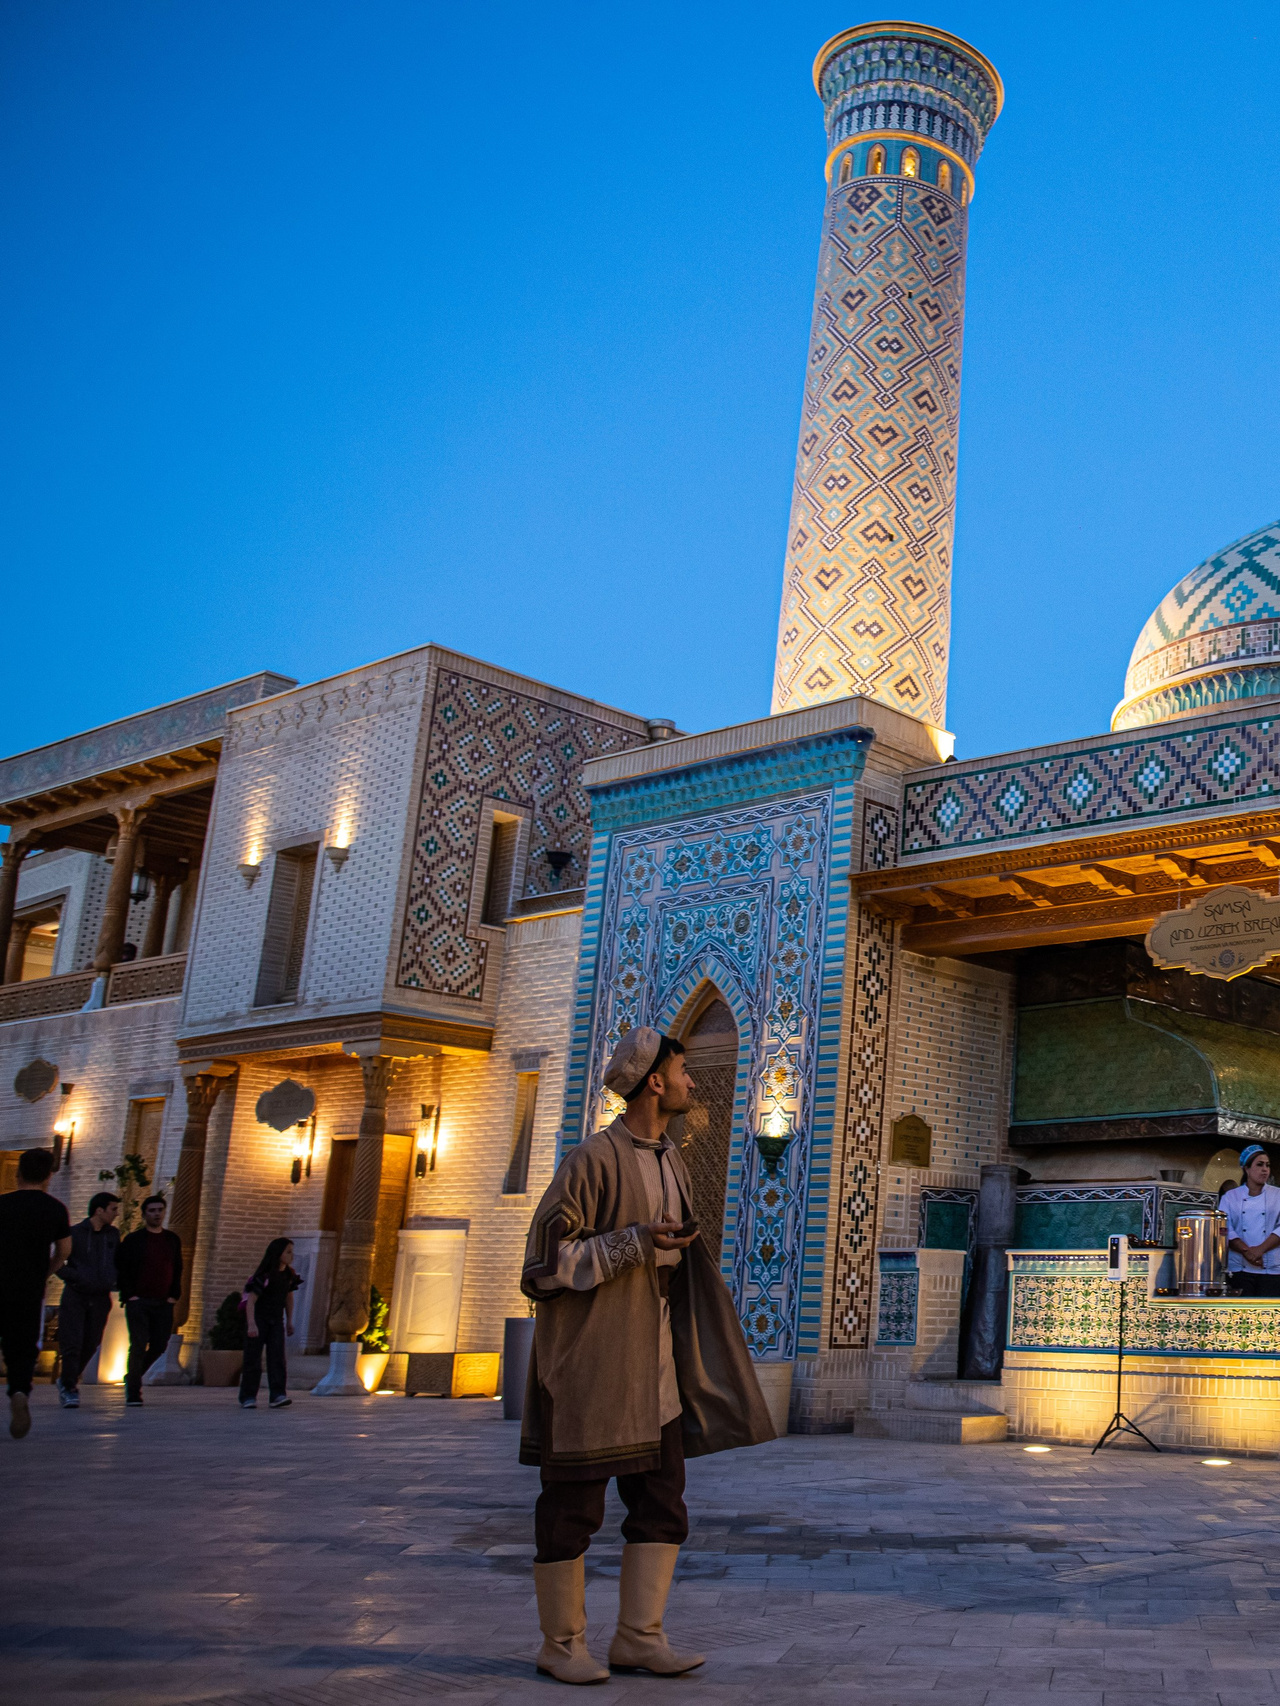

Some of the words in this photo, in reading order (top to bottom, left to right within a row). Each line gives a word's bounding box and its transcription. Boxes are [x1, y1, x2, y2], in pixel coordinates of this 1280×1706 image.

[1204, 900, 1252, 921] SAMSA
[1170, 928, 1194, 947] AND
[1198, 922, 1240, 938] UZBEK
